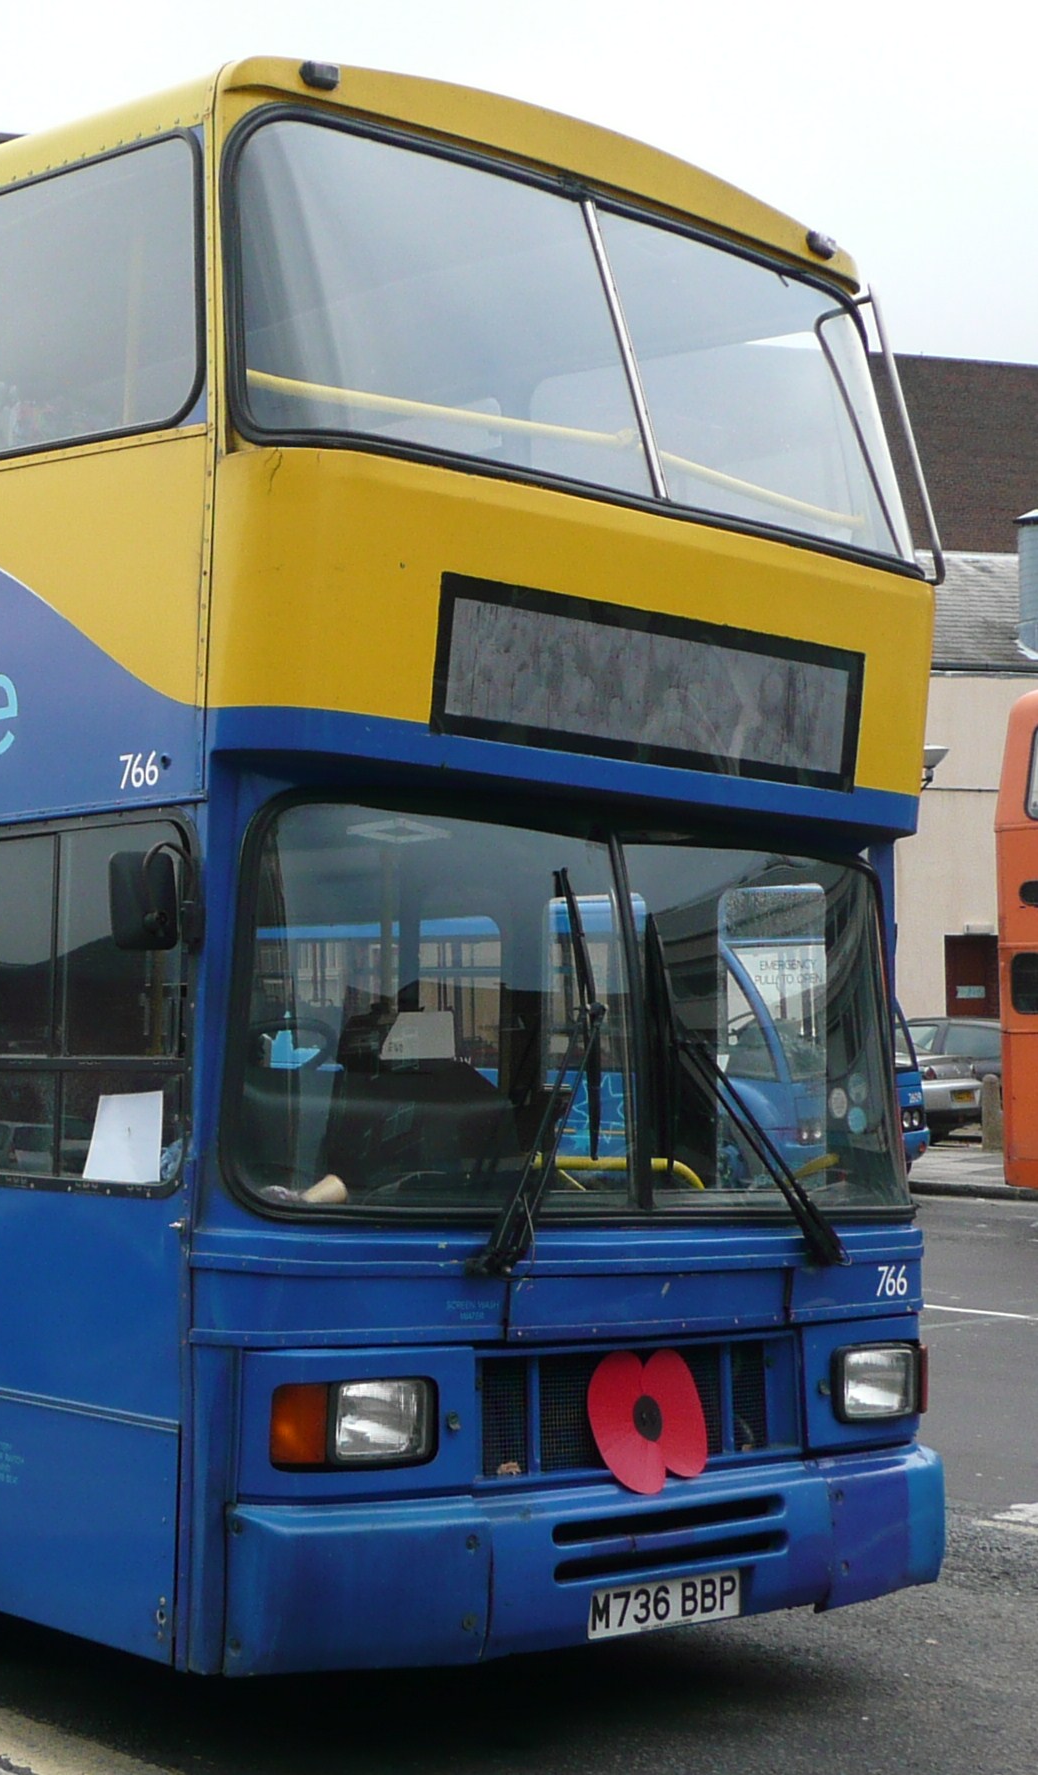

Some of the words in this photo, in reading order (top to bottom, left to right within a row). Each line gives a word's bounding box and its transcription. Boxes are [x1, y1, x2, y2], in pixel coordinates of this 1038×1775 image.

[119, 750, 159, 790] 766
[759, 958, 818, 971] EMERGENCY
[876, 1264, 907, 1297] 766
[591, 1585, 670, 1631] M736
[681, 1575, 736, 1617] BBP
